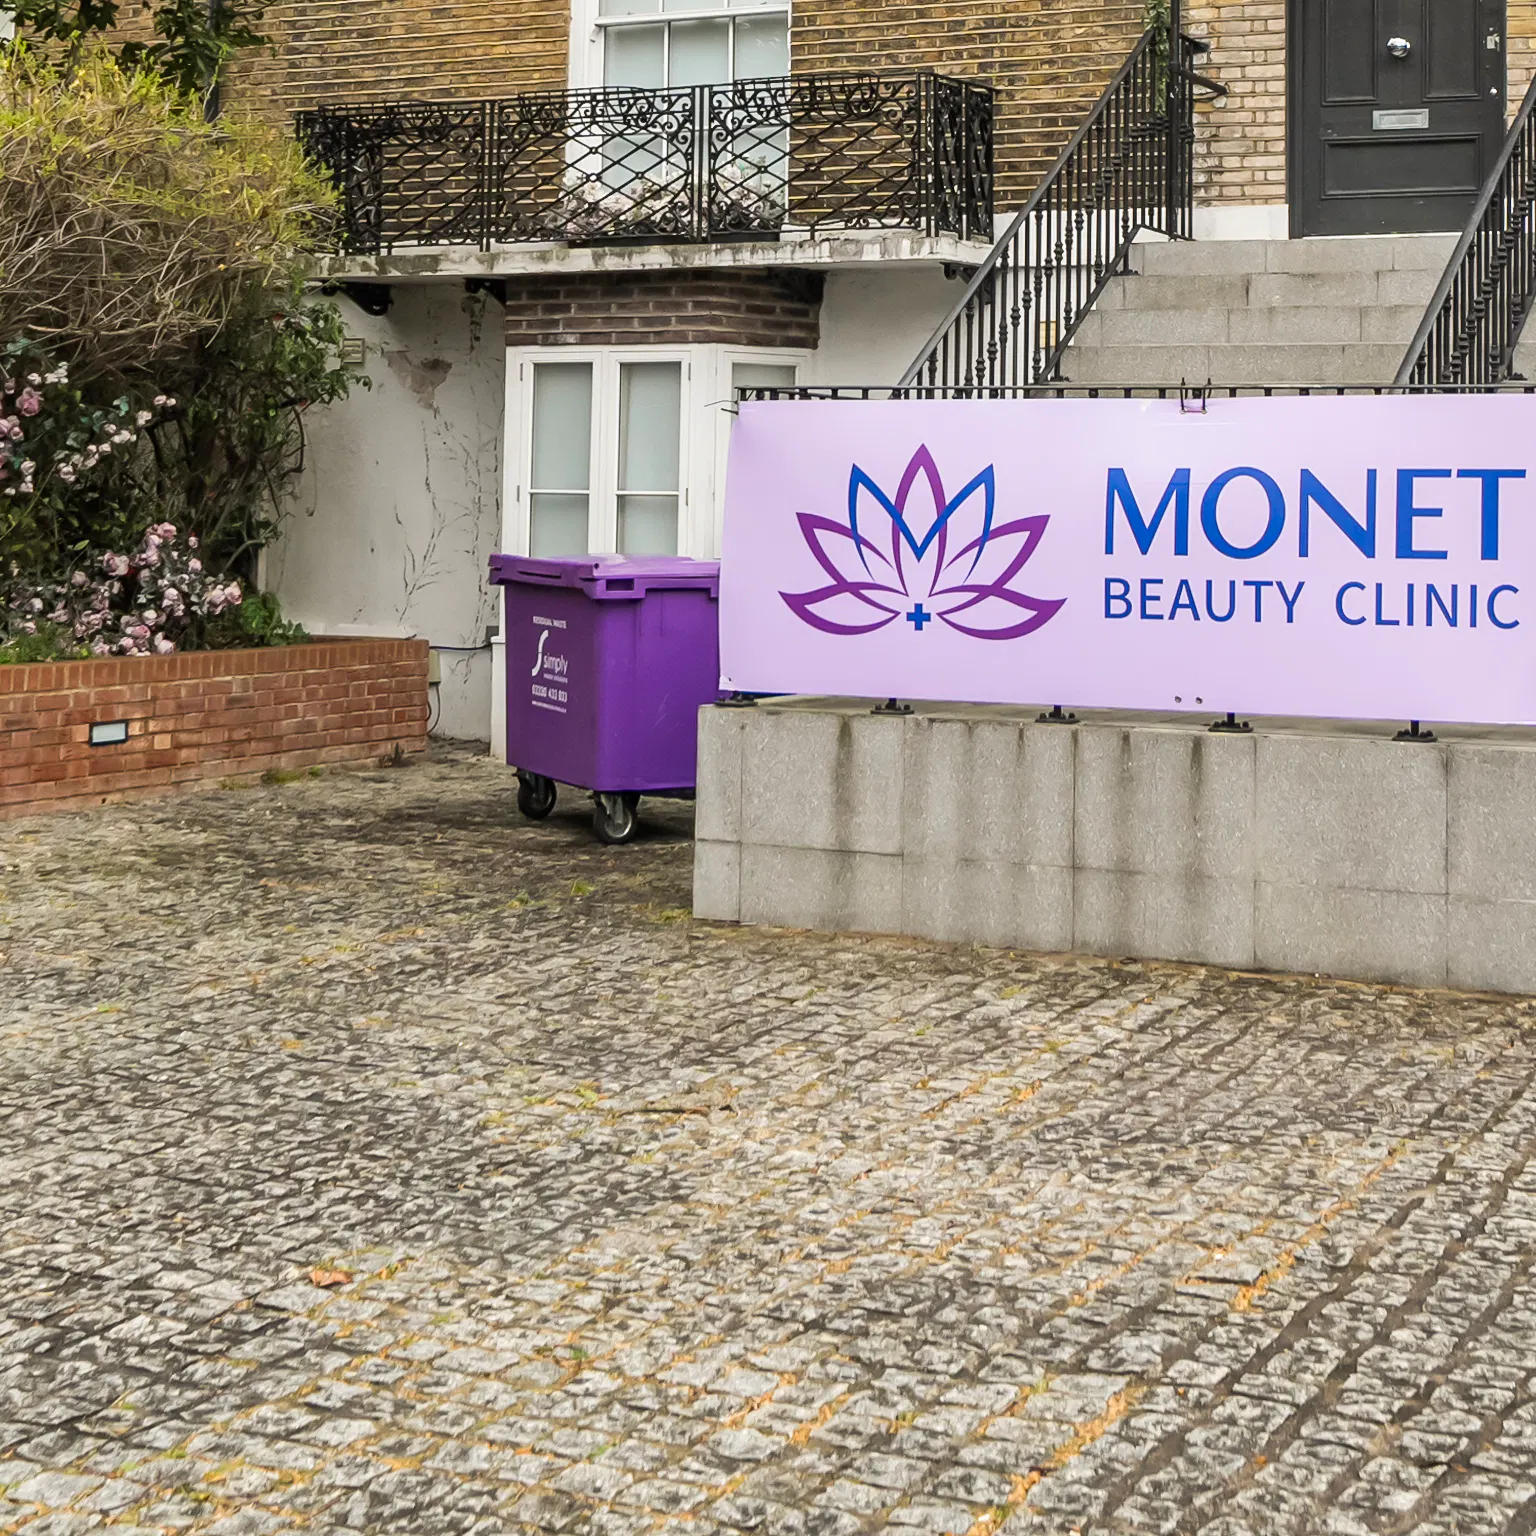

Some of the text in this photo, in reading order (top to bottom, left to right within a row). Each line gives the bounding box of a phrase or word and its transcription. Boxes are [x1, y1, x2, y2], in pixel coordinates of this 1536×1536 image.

[1104, 466, 1527, 561] MONET
[1104, 577, 1521, 630] BEAUTY CLINIC
[544, 653, 568, 675] simply
